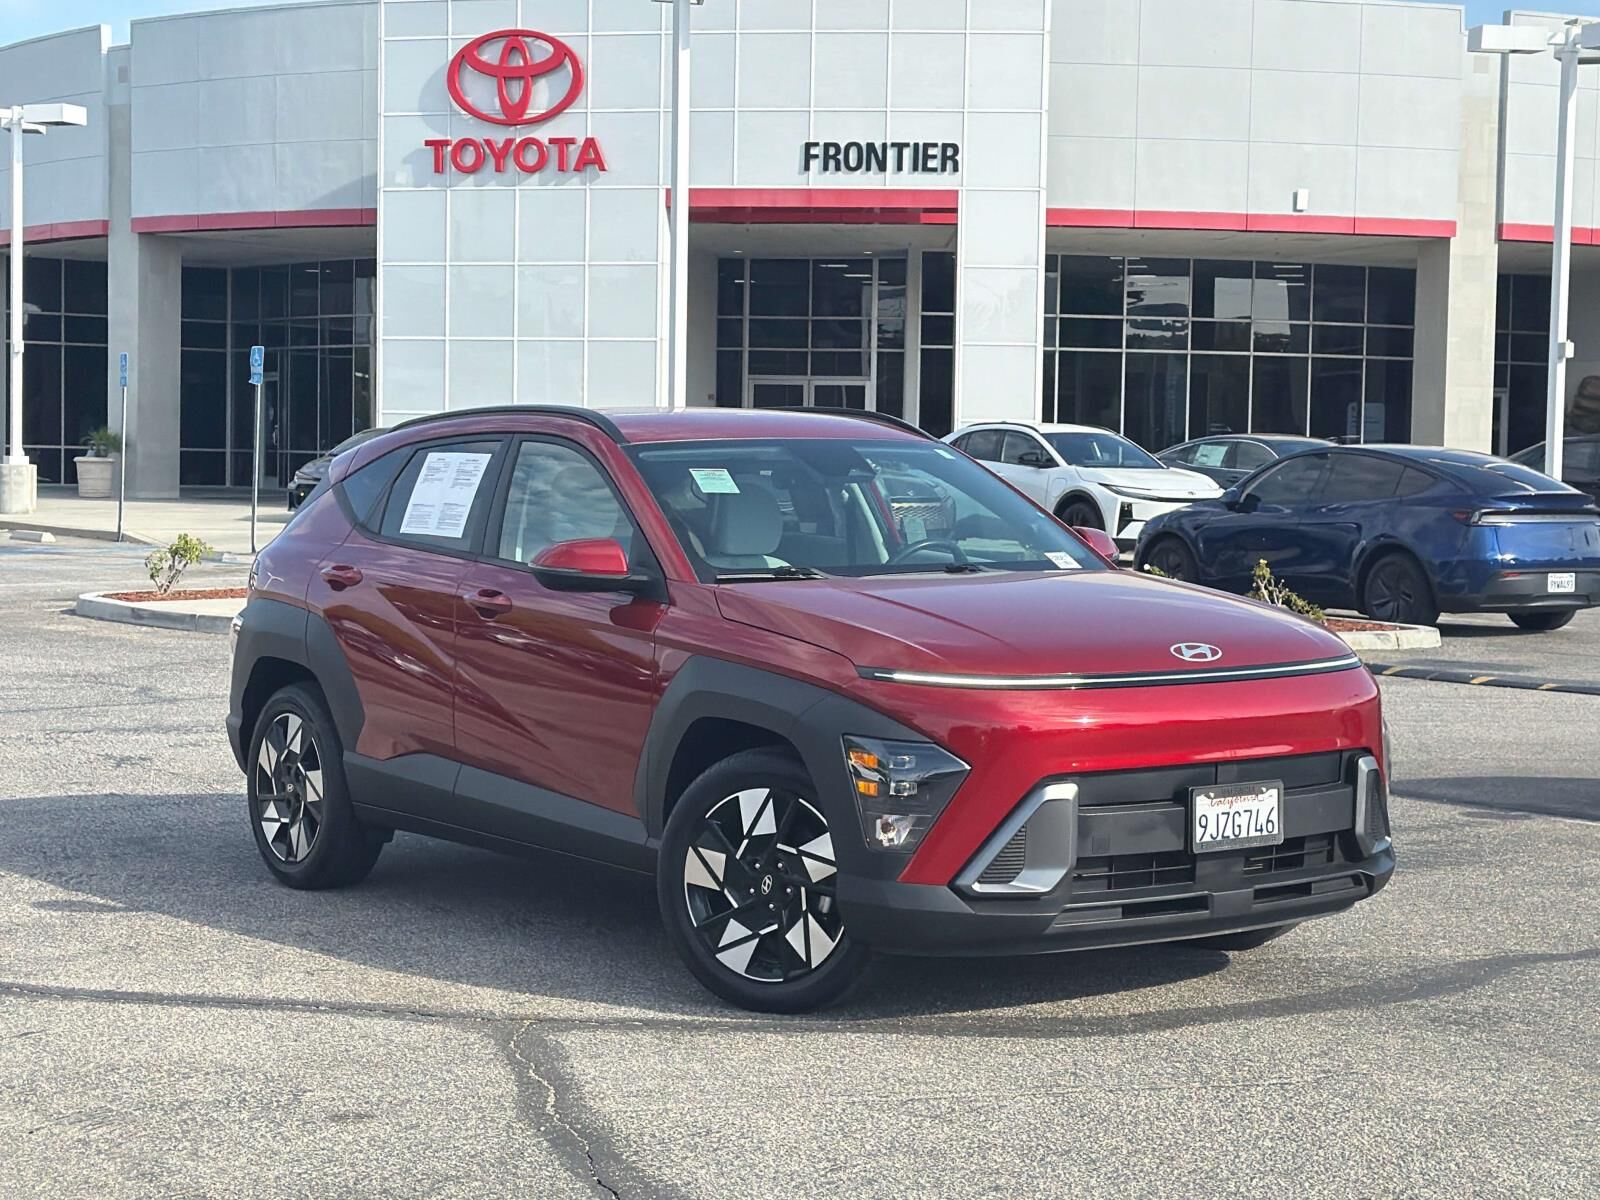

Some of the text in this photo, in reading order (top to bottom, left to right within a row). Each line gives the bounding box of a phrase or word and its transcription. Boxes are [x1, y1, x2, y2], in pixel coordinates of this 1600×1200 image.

[424, 137, 608, 173] TOYOTA
[803, 141, 960, 173] FRONTIER
[1198, 806, 1275, 842] 9JZG746
